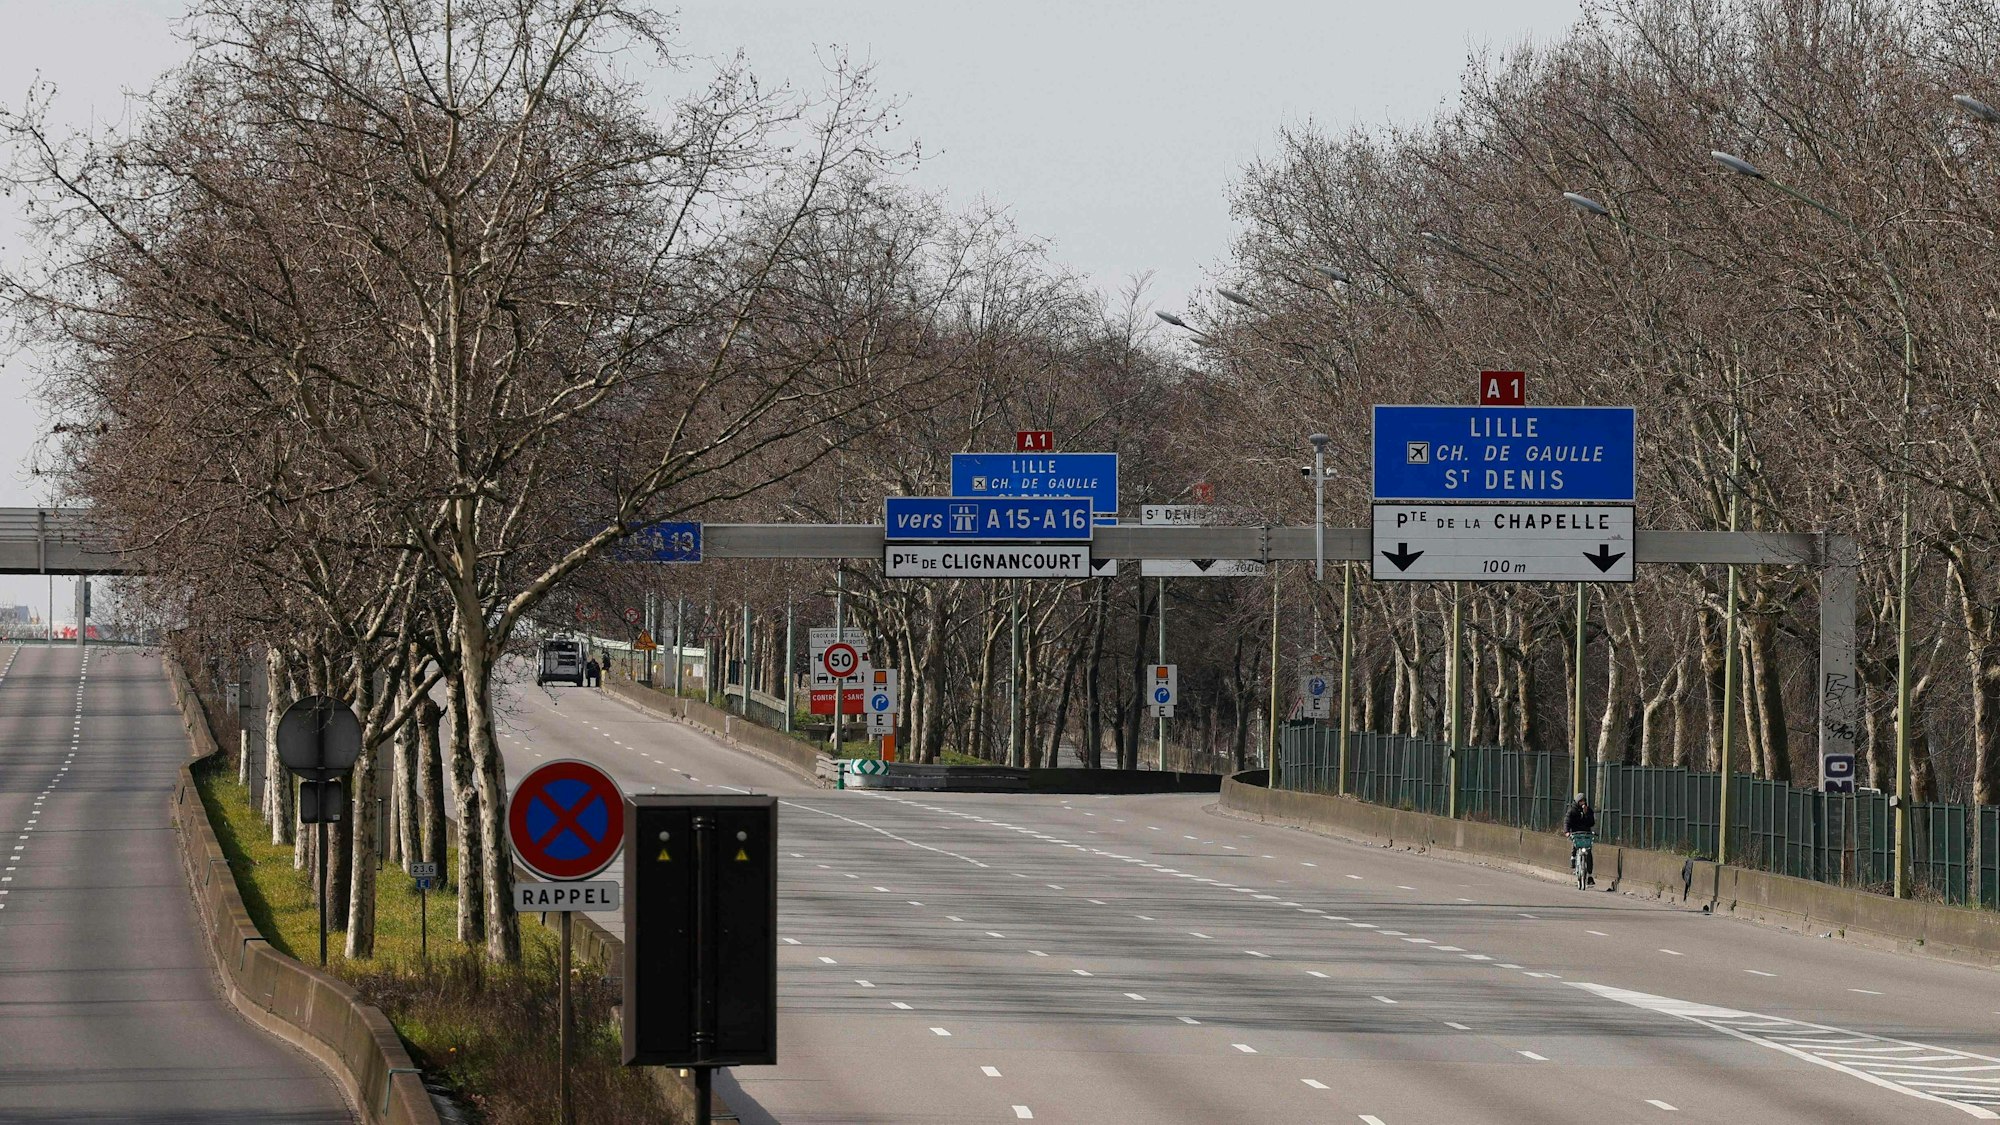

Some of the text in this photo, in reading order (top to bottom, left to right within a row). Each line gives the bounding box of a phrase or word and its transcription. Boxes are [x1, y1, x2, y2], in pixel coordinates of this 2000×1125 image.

[1486, 378, 1519, 398] A 1
[1470, 417, 1539, 438] LILLE
[1024, 433, 1046, 447] A 1
[1436, 444, 1604, 462] CH. DE GAULLE
[1012, 460, 1056, 474] LILLE
[991, 478, 1098, 489] CH. DE GAULLE
[1444, 469, 1564, 490] ST DENIS
[897, 513, 943, 529] vers
[1146, 509, 1159, 520] ST
[1397, 511, 1610, 530] PTE DE LA CHAPELLE
[892, 553, 1082, 569] PTE DE CLIGNANCOURT
[1482, 560, 1526, 573] 100 m
[831, 653, 851, 667] 50
[1314, 698, 1320, 710] E
[1159, 706, 1165, 717] E
[876, 714, 884, 726] E
[413, 865, 434, 873] 23.6
[522, 888, 610, 905] RAPPEL
